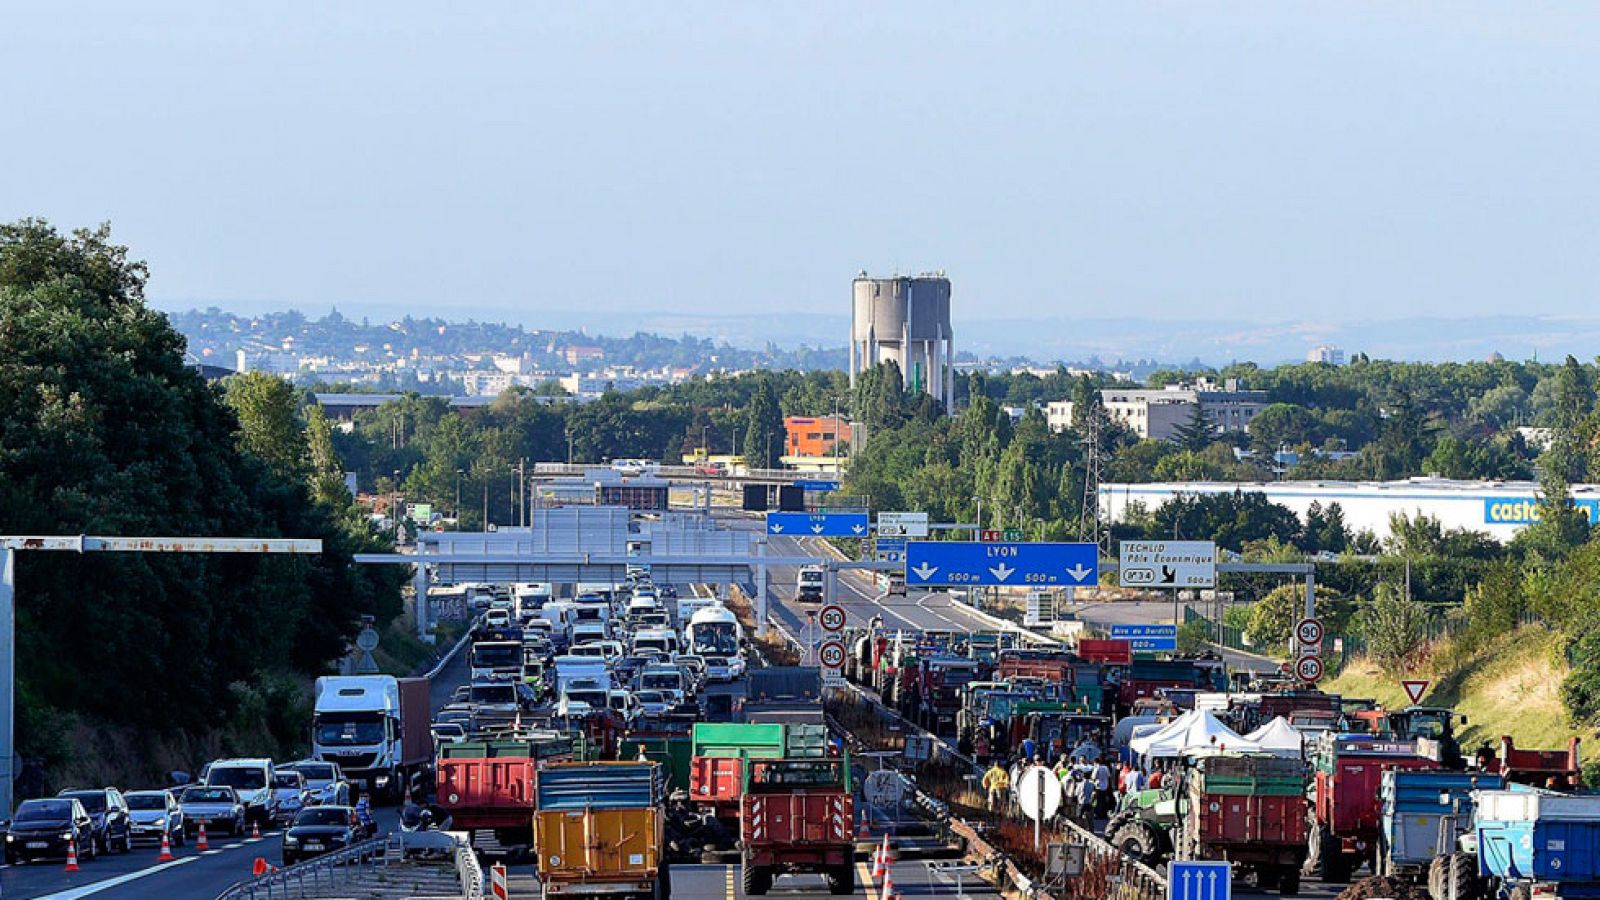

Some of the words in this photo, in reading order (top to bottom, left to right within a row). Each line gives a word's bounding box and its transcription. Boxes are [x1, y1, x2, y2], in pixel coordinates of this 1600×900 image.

[987, 546, 1018, 557] LYON
[1124, 543, 1165, 552] TECHLID
[947, 572, 969, 582] 500
[1024, 572, 1046, 582] 500
[1048, 574, 1057, 582] m
[825, 613, 841, 624] 90
[1302, 626, 1317, 637] 90
[825, 649, 841, 660] 80
[1302, 663, 1317, 675] 80
